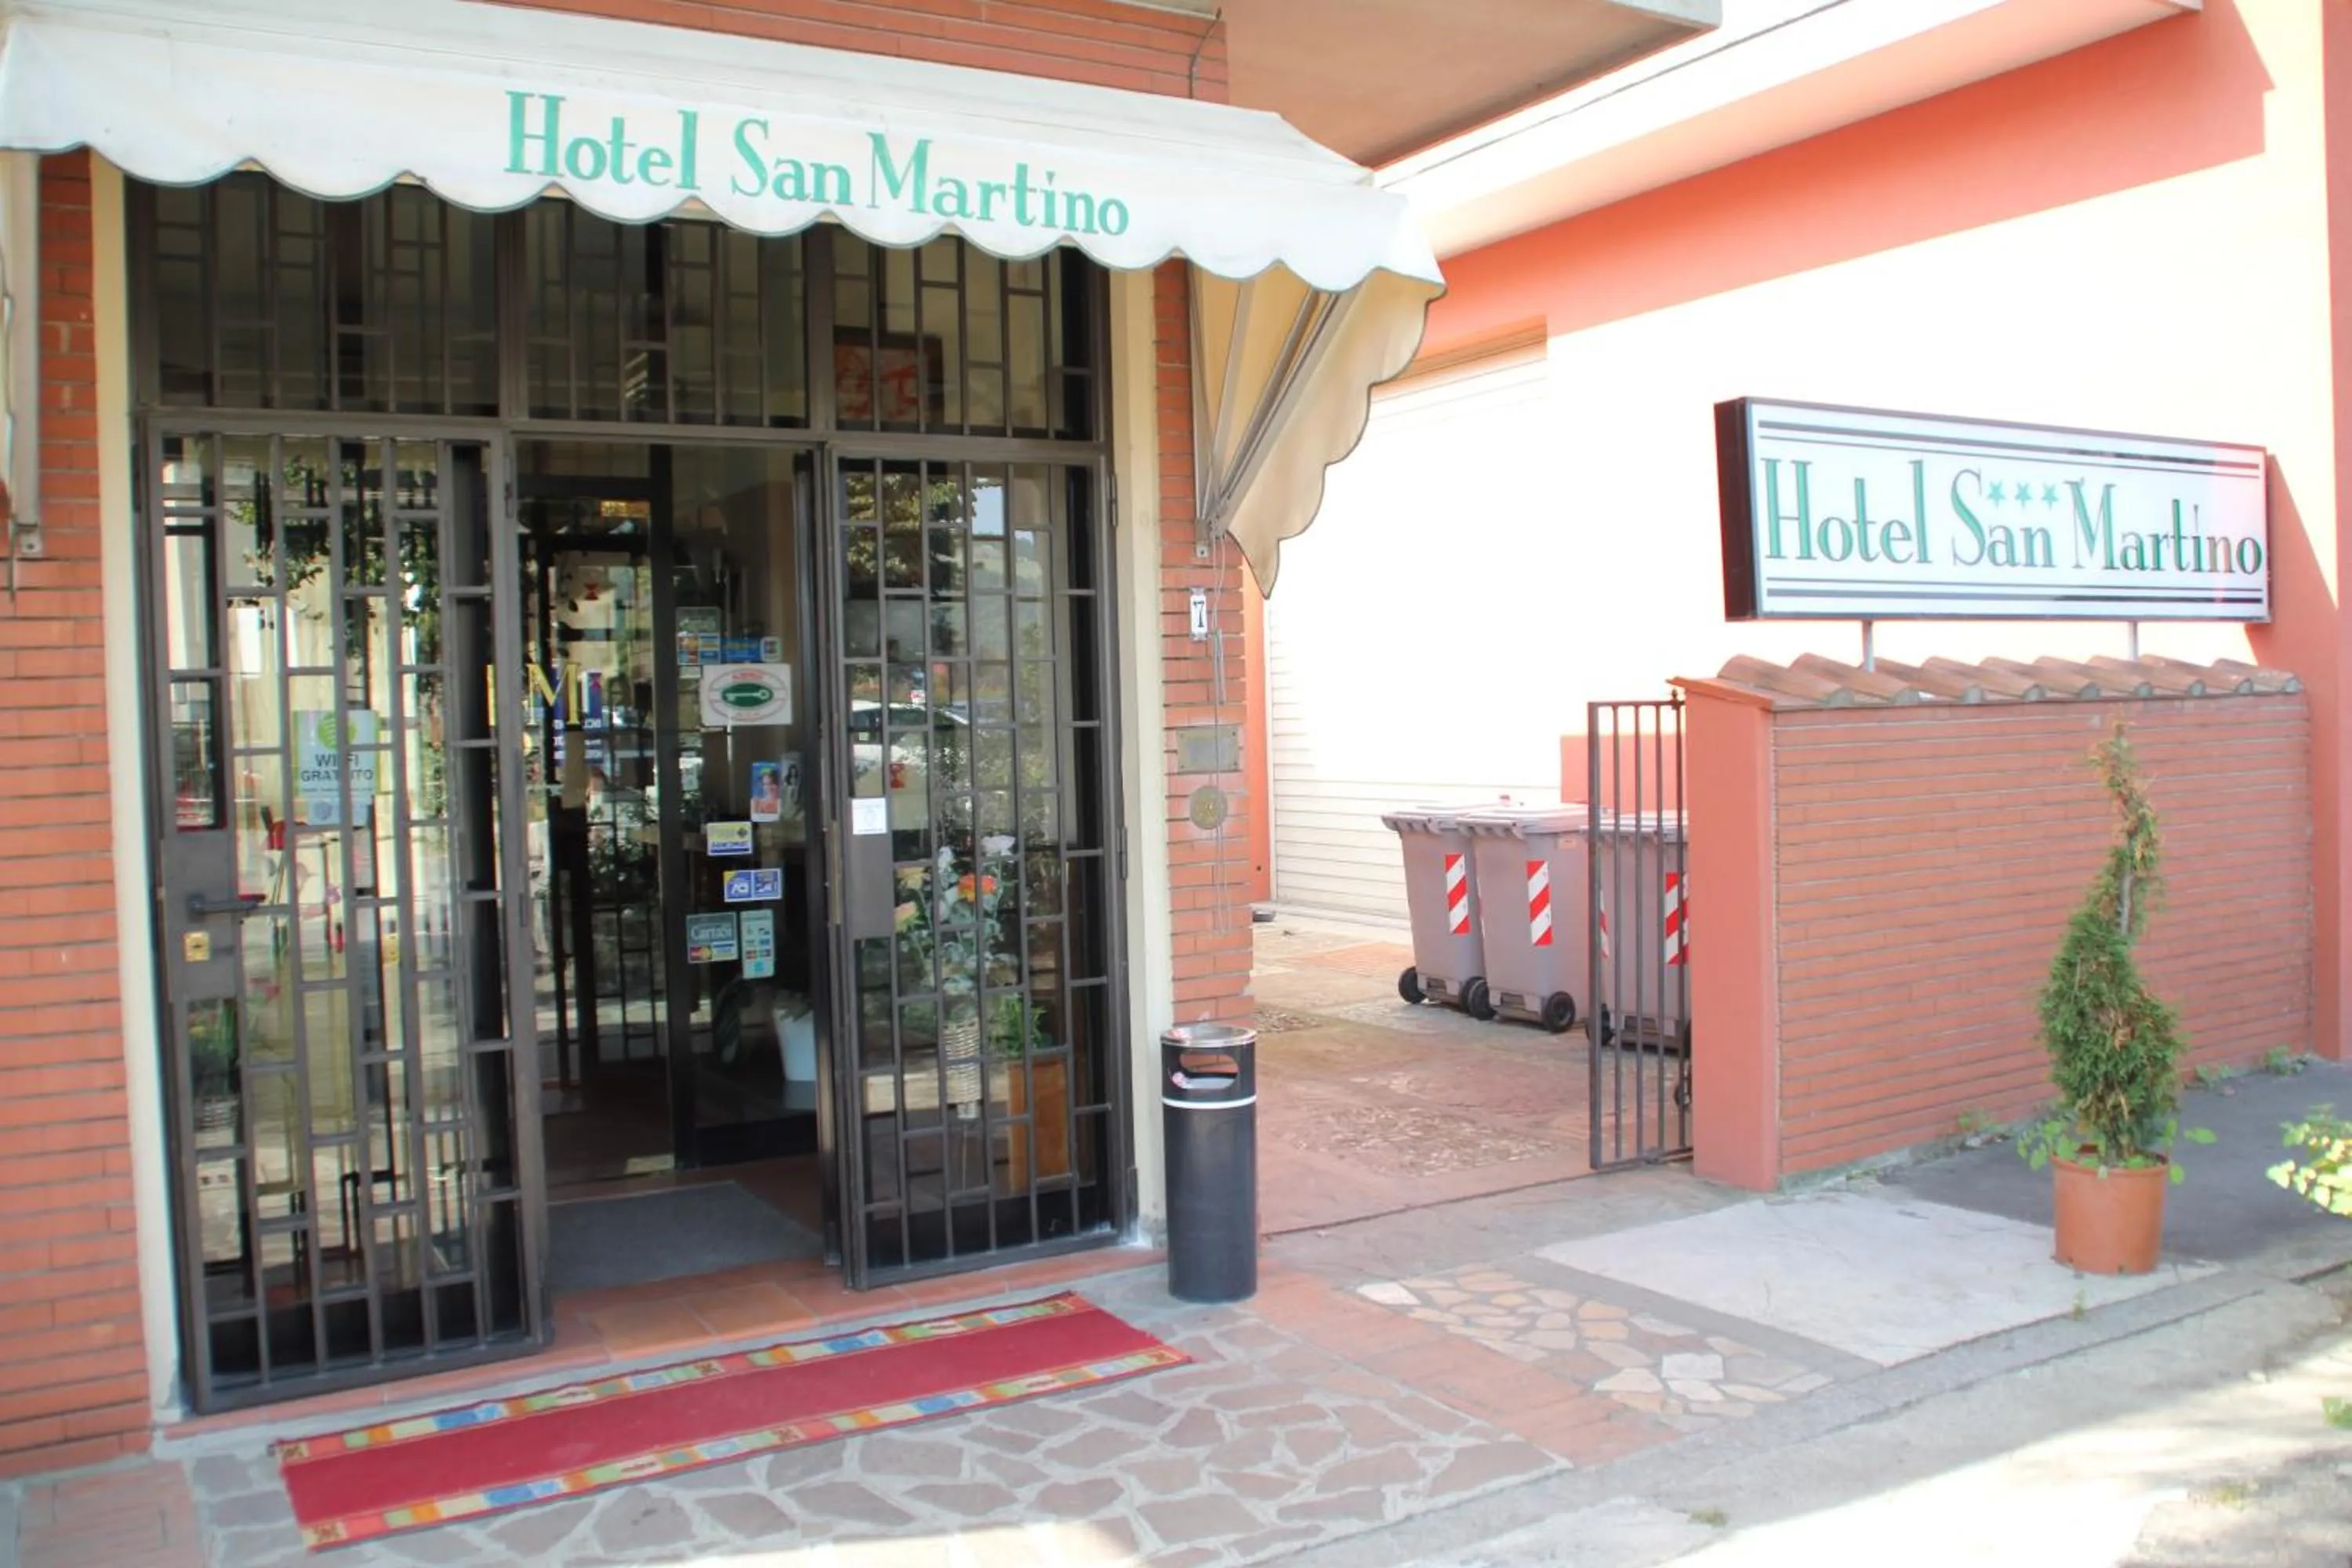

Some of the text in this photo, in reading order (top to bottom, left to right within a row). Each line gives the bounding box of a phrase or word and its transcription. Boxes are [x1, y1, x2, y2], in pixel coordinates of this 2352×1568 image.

[504, 89, 1131, 237] Hotel San Martino
[1761, 458, 2263, 575] Hotel San Martino
[301, 769, 374, 782] GRATITO
